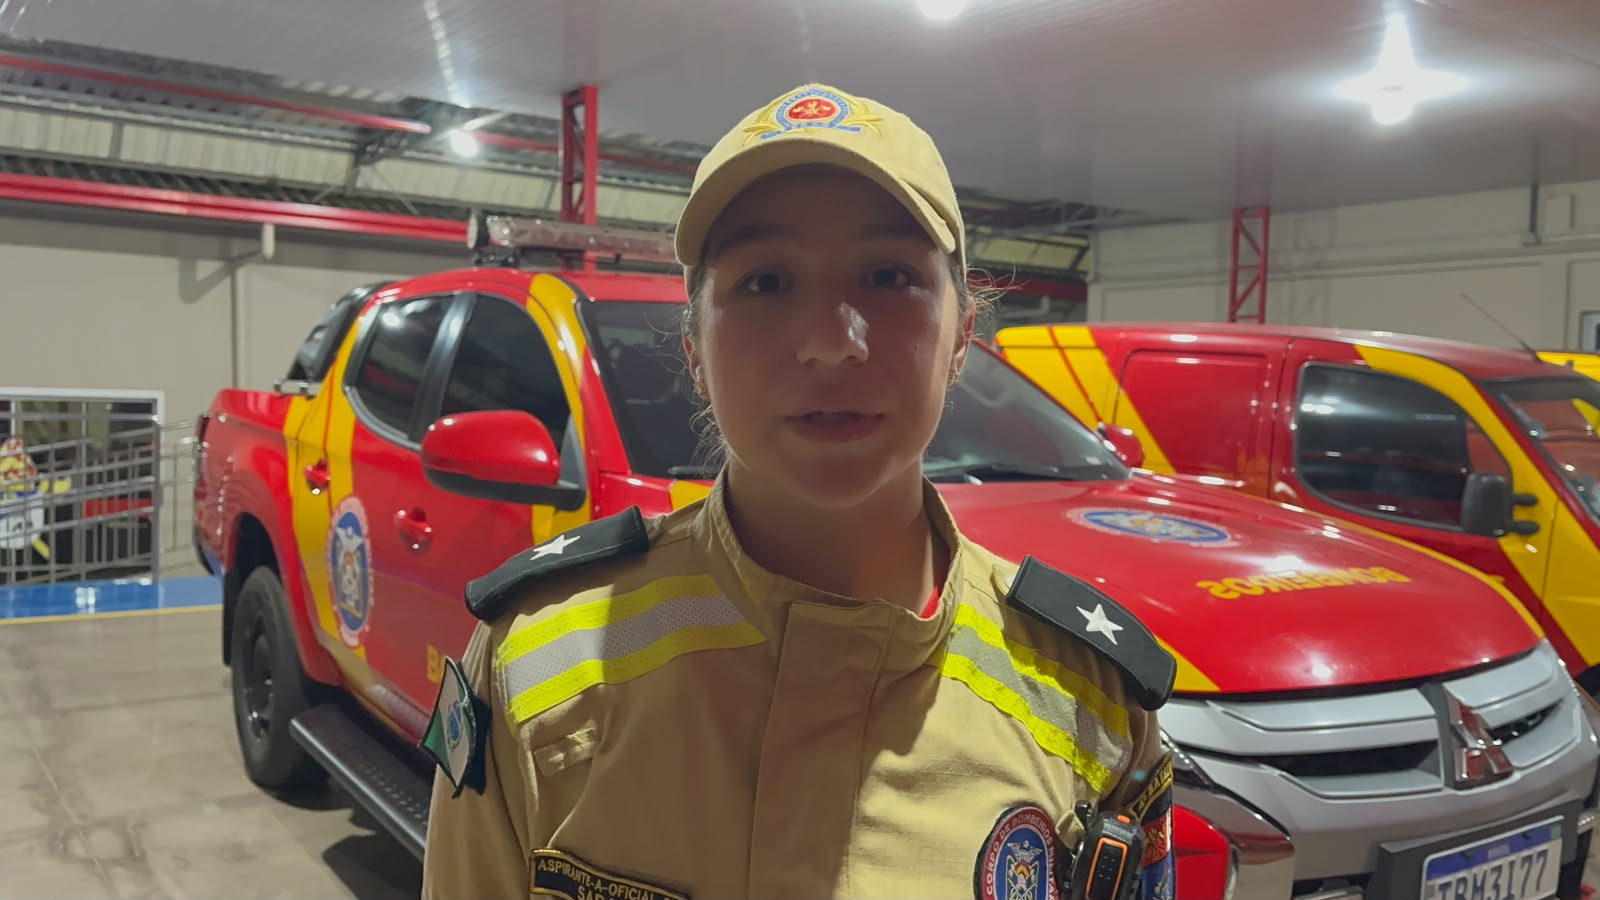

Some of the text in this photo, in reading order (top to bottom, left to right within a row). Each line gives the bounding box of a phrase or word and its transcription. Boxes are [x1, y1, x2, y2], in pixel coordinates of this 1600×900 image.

[986, 841, 1000, 895] CORPO
[1000, 824, 1011, 839] DE
[1012, 813, 1054, 846] BOMBEIROS
